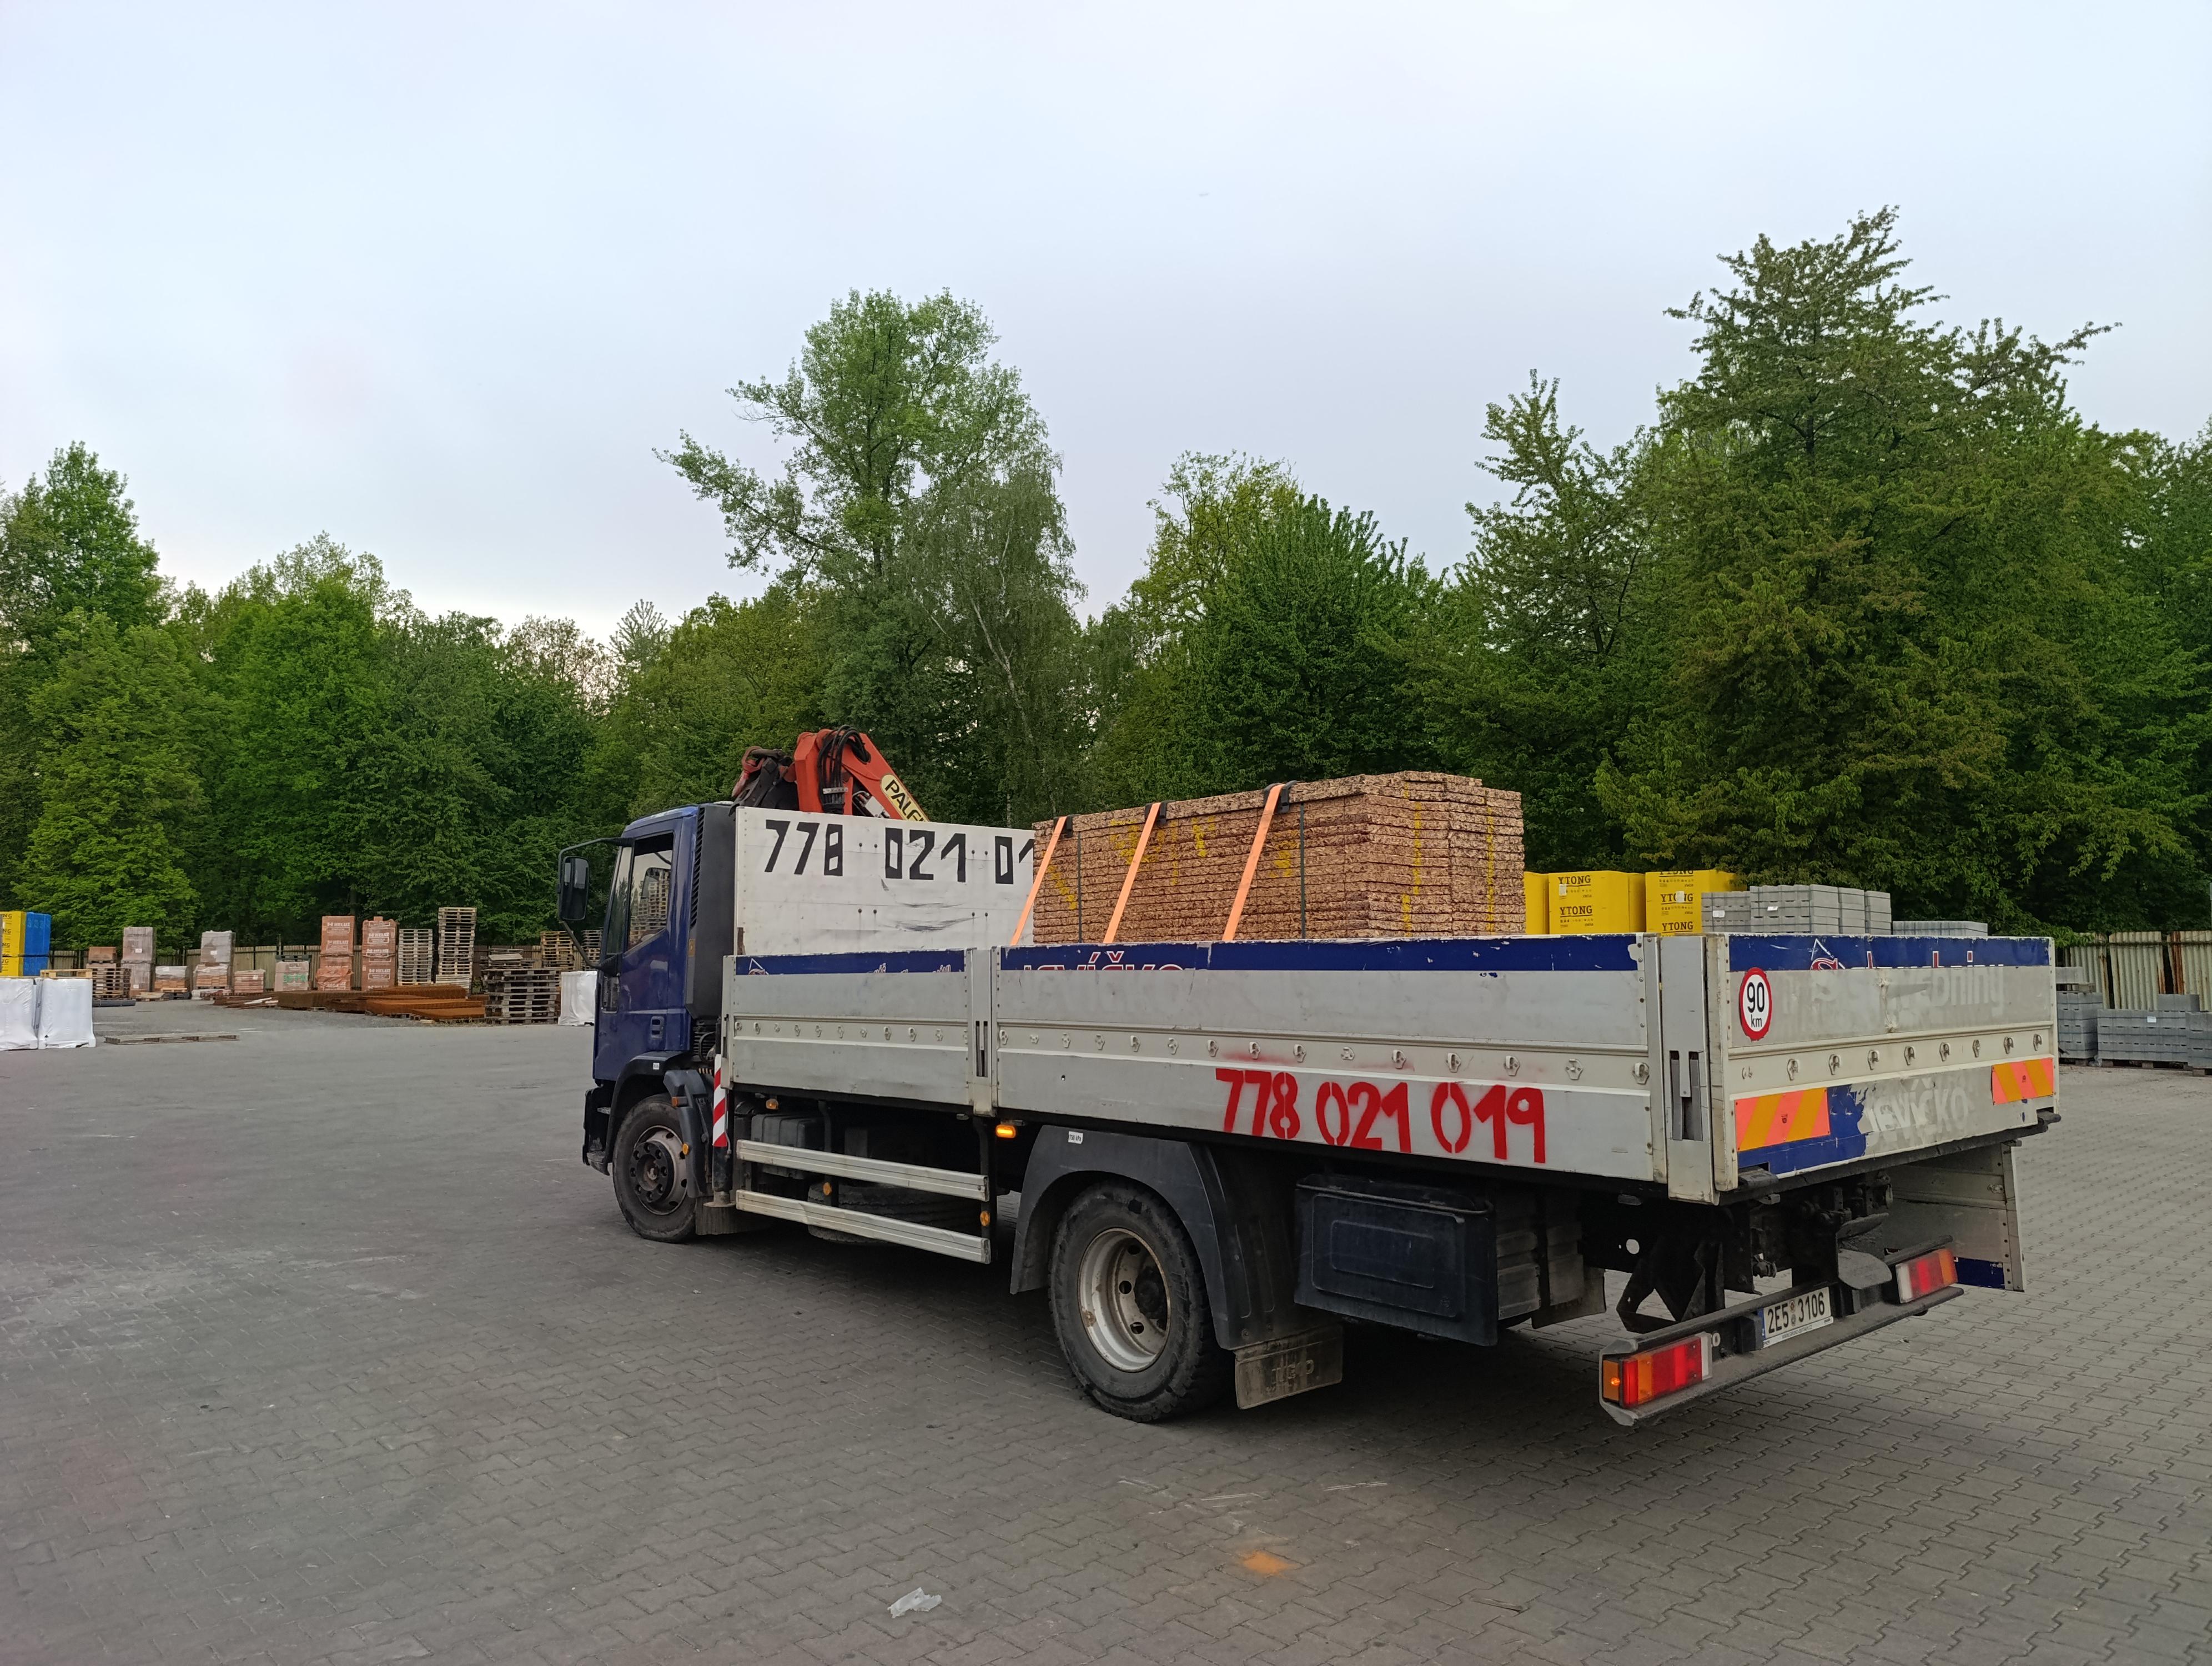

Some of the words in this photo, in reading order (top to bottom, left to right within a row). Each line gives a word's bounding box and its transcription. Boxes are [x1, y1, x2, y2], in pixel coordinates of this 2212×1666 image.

[764, 819, 843, 876] 778
[885, 827, 966, 883] 021
[1558, 875, 1591, 885] YTONG
[1560, 905, 1592, 915] YTONG
[1662, 921, 1693, 931] YTONG
[1747, 982, 1764, 1013] 90
[1751, 1014, 1762, 1028] km
[1215, 1068, 1300, 1140] 778
[1316, 1081, 1411, 1153] 021
[1431, 1082, 1546, 1164] 019
[1768, 1303, 1789, 1334] 2E5
[1798, 1292, 1825, 1323] 3106
